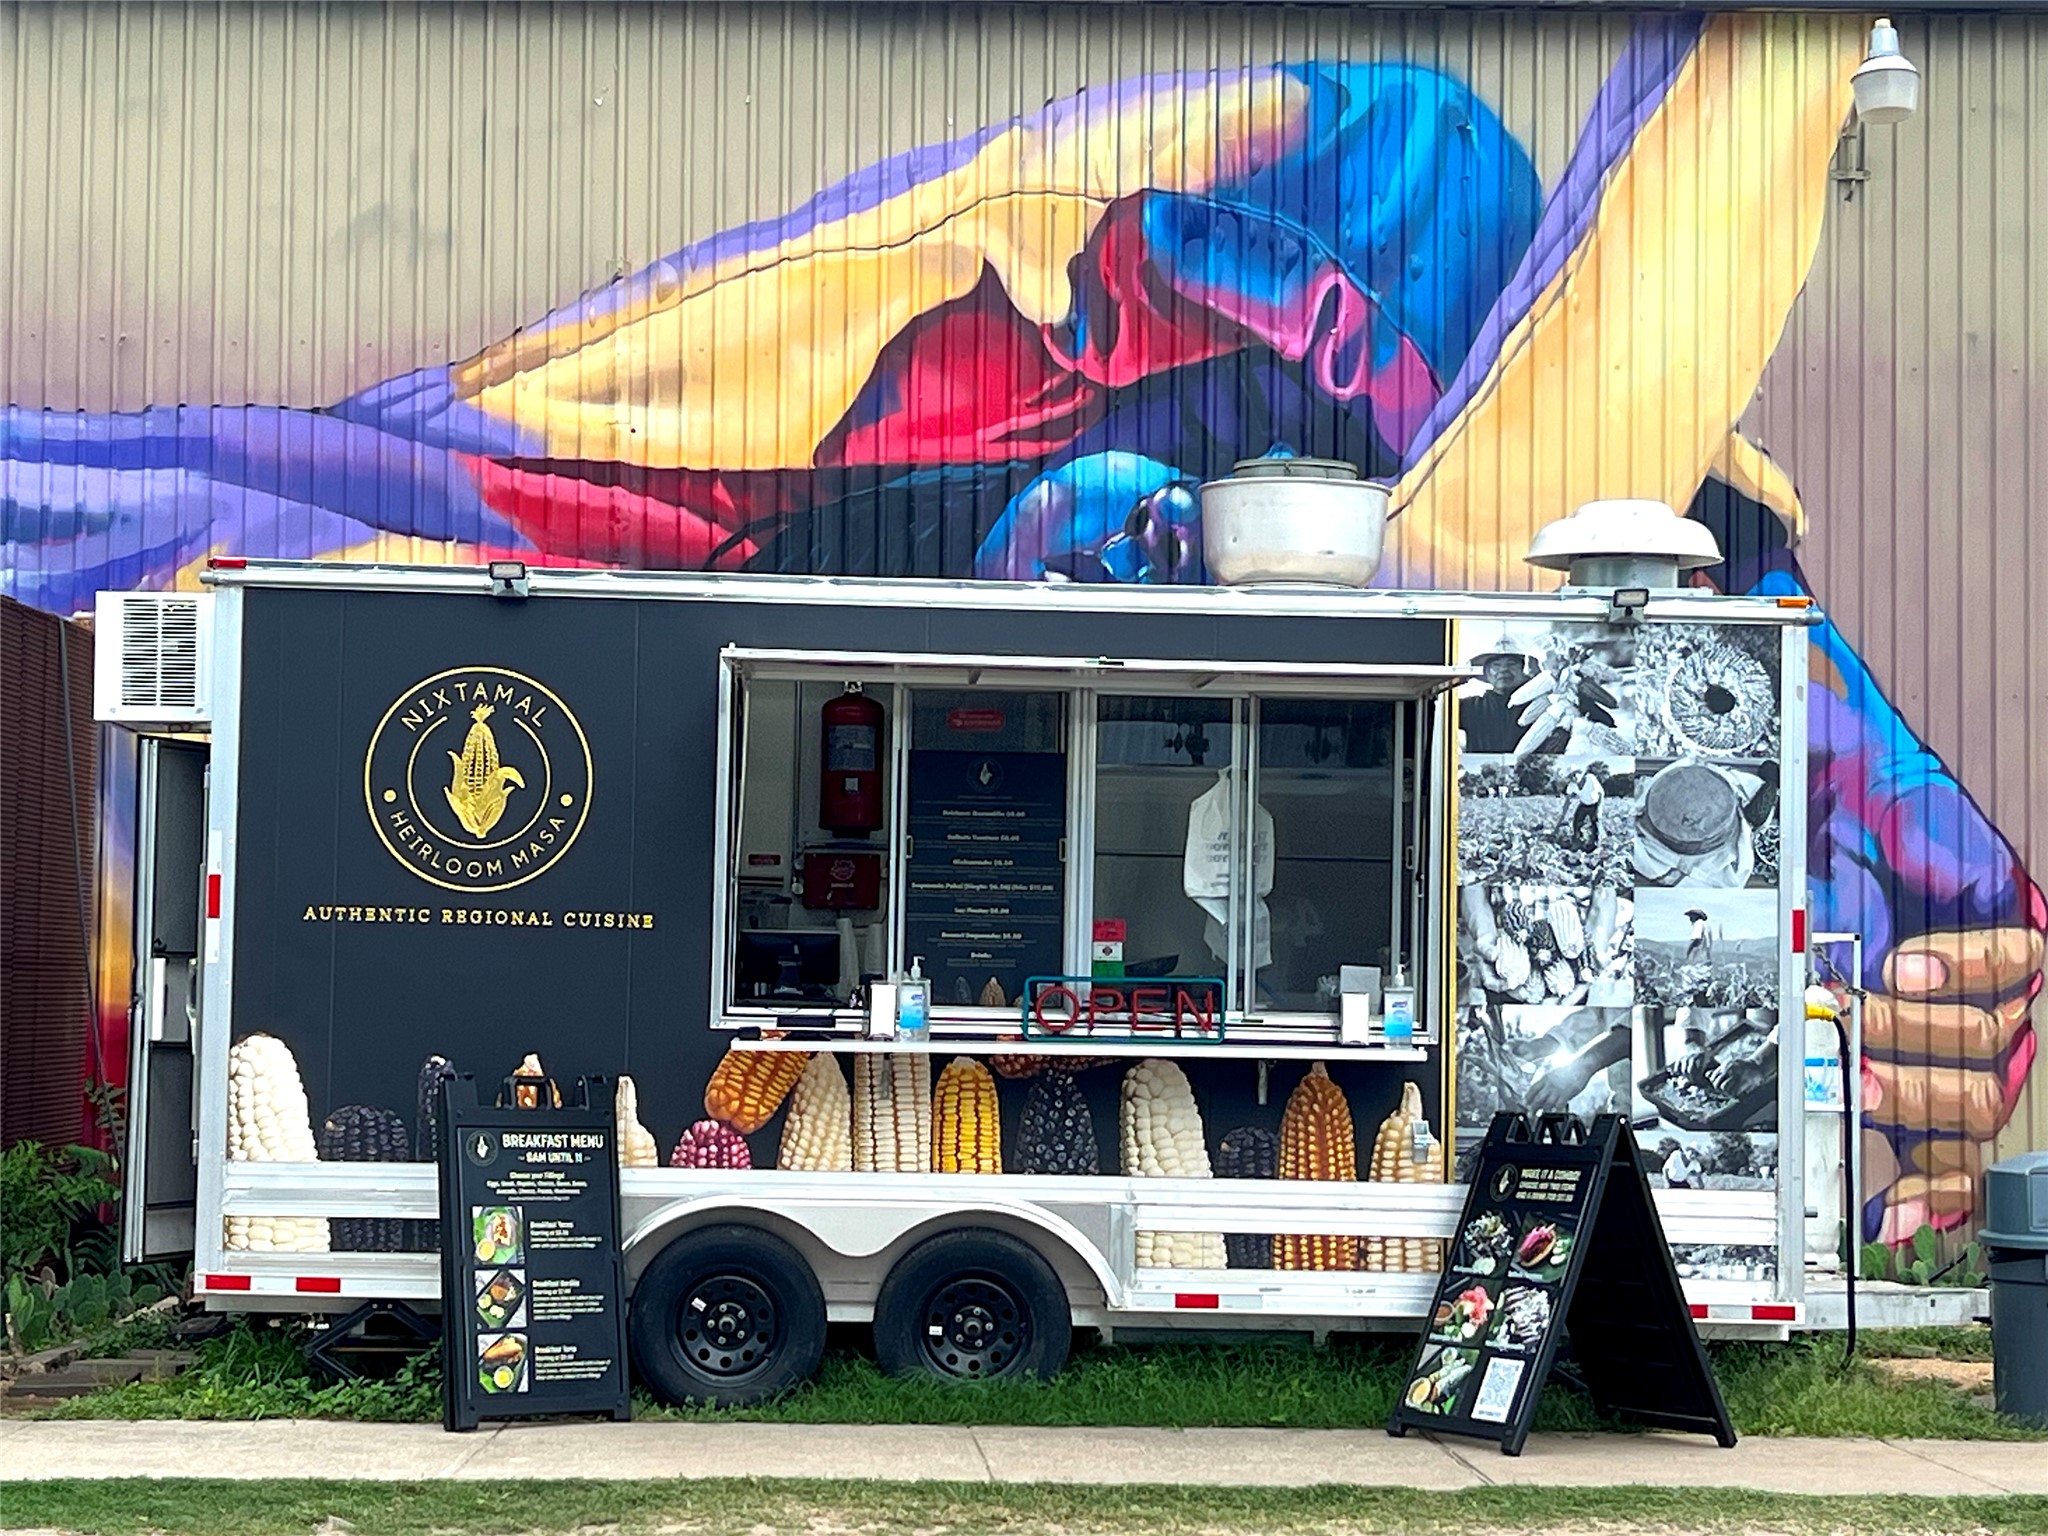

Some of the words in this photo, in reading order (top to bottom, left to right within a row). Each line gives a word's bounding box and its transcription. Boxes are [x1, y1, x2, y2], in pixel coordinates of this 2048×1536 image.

[401, 682, 547, 732] NIXTAMAL
[390, 810, 504, 878] HEIRLOOM
[511, 817, 566, 869] MASA
[303, 906, 431, 923] AUTHENTIC
[441, 909, 553, 926] REGIONAL
[563, 912, 654, 928] CUISINE
[1035, 985, 1213, 1033] OPEN
[502, 1133, 568, 1148] BREAKFAST
[570, 1134, 604, 1148] MENU
